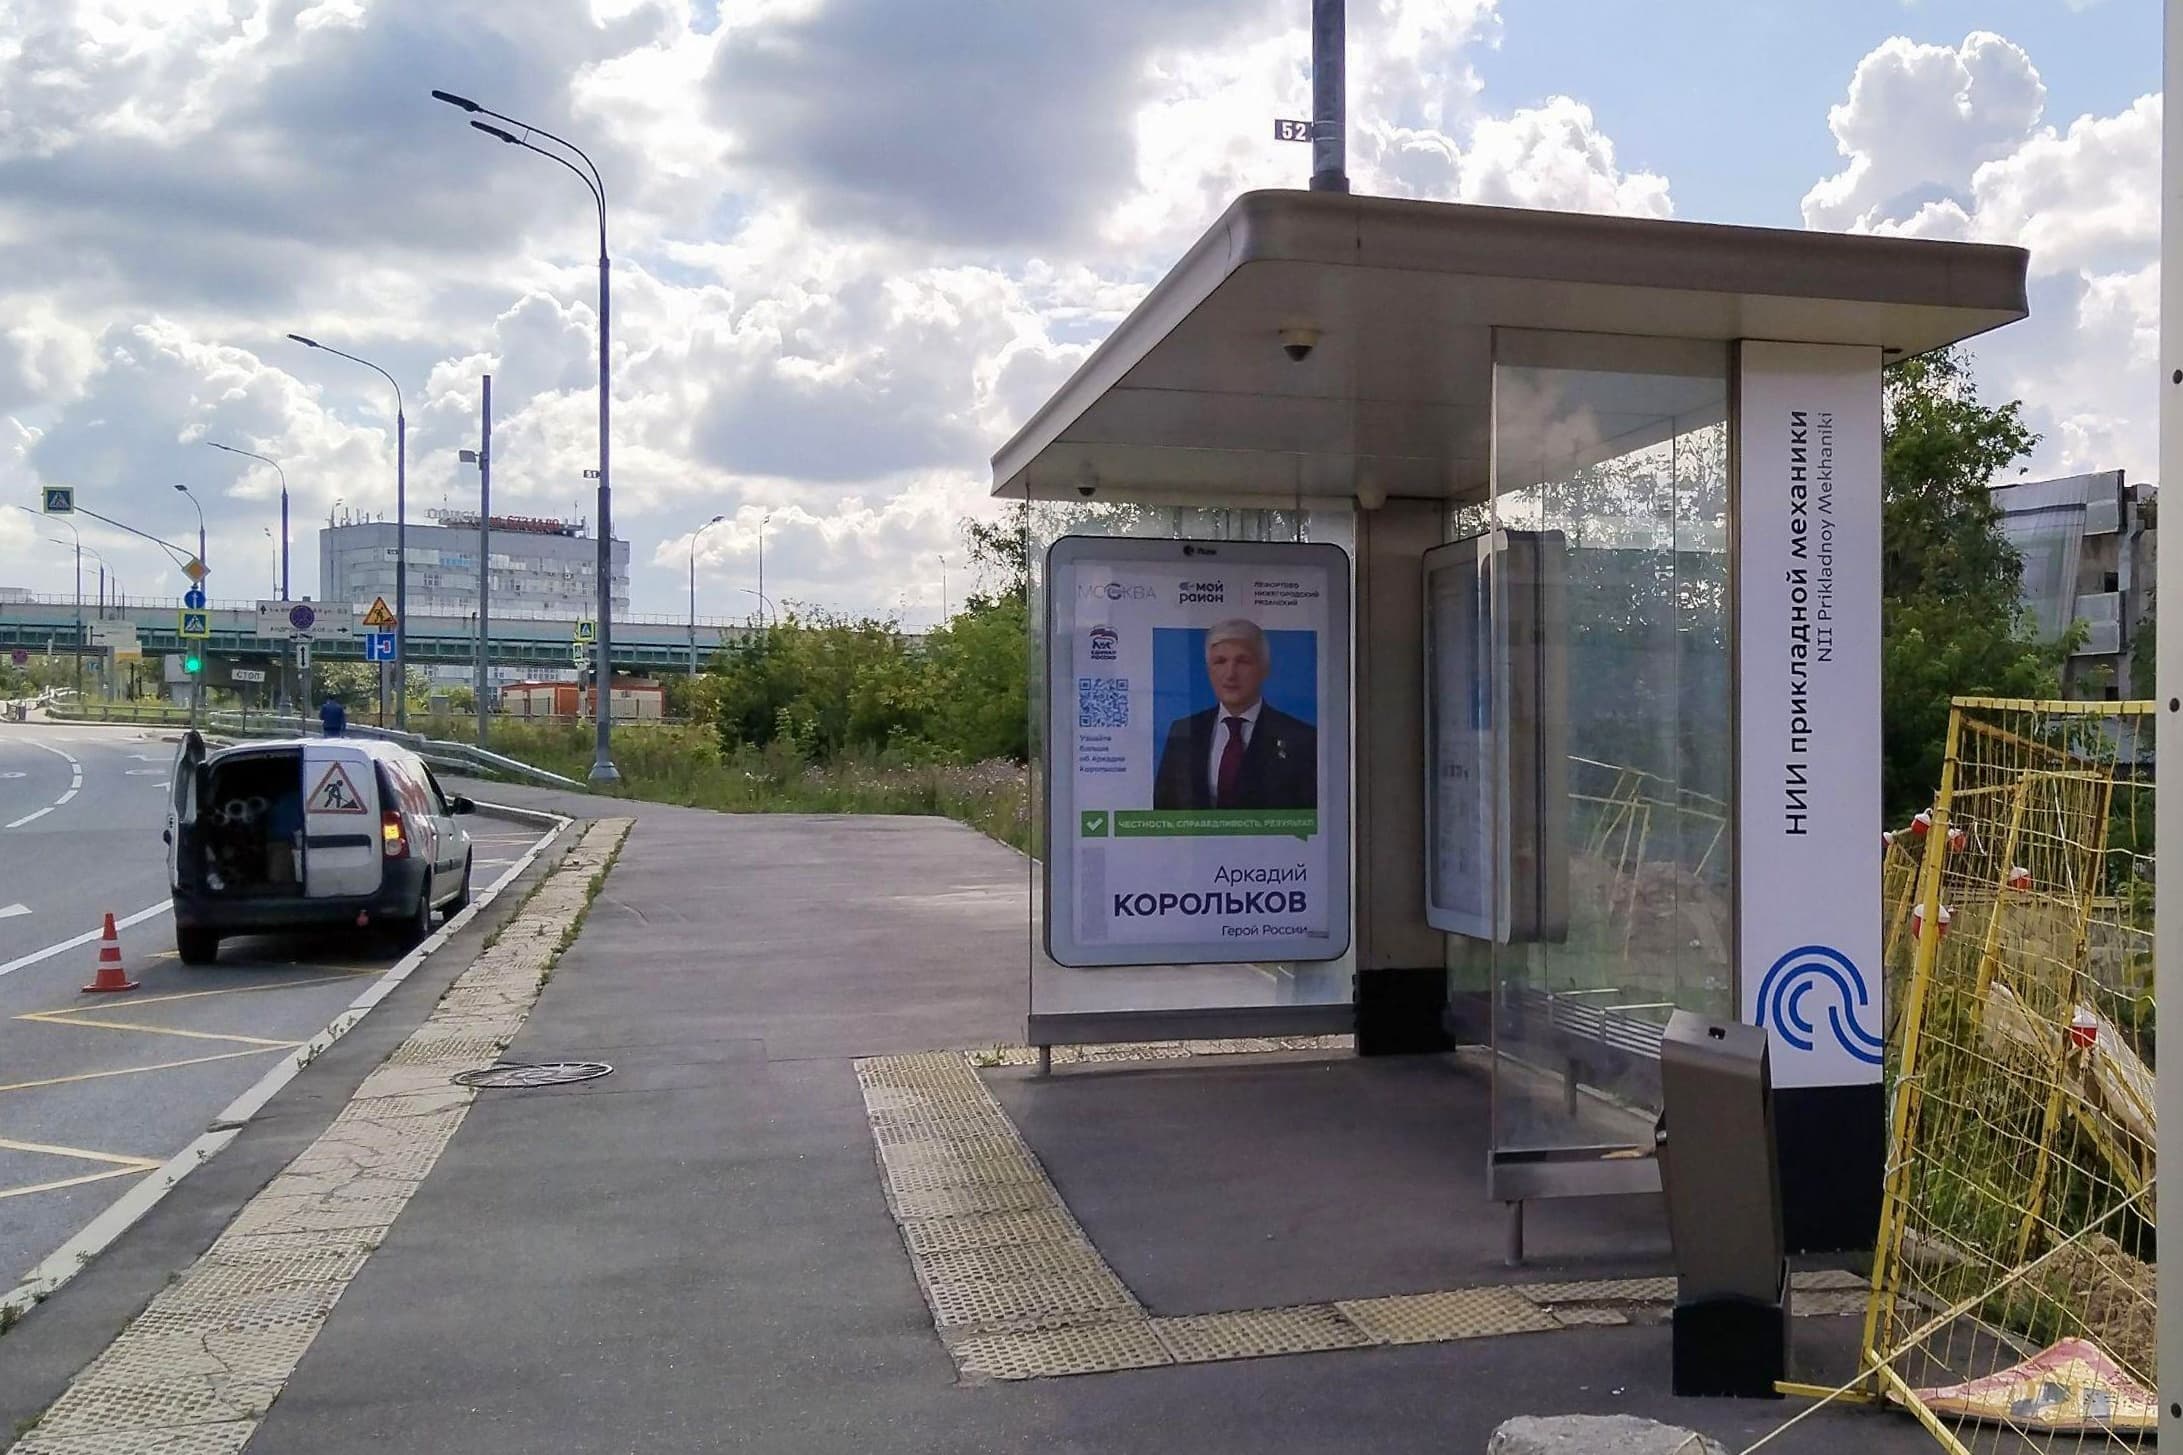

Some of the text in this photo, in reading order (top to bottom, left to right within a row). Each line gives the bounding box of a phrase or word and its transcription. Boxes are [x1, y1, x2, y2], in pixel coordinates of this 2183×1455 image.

[1281, 121, 1306, 141] 52
[1817, 412, 1836, 662] NII Prikladnoy Mekhaniki
[1078, 583, 1157, 600] МОСКВА
[1196, 580, 1223, 592] мой
[1785, 411, 1812, 834] НИИ прикладной механики
[1214, 863, 1307, 887] Аркадий
[1114, 891, 1307, 917] КОРОЛЬКОВ
[1222, 924, 1259, 938] Герой
[1262, 924, 1307, 937] России
